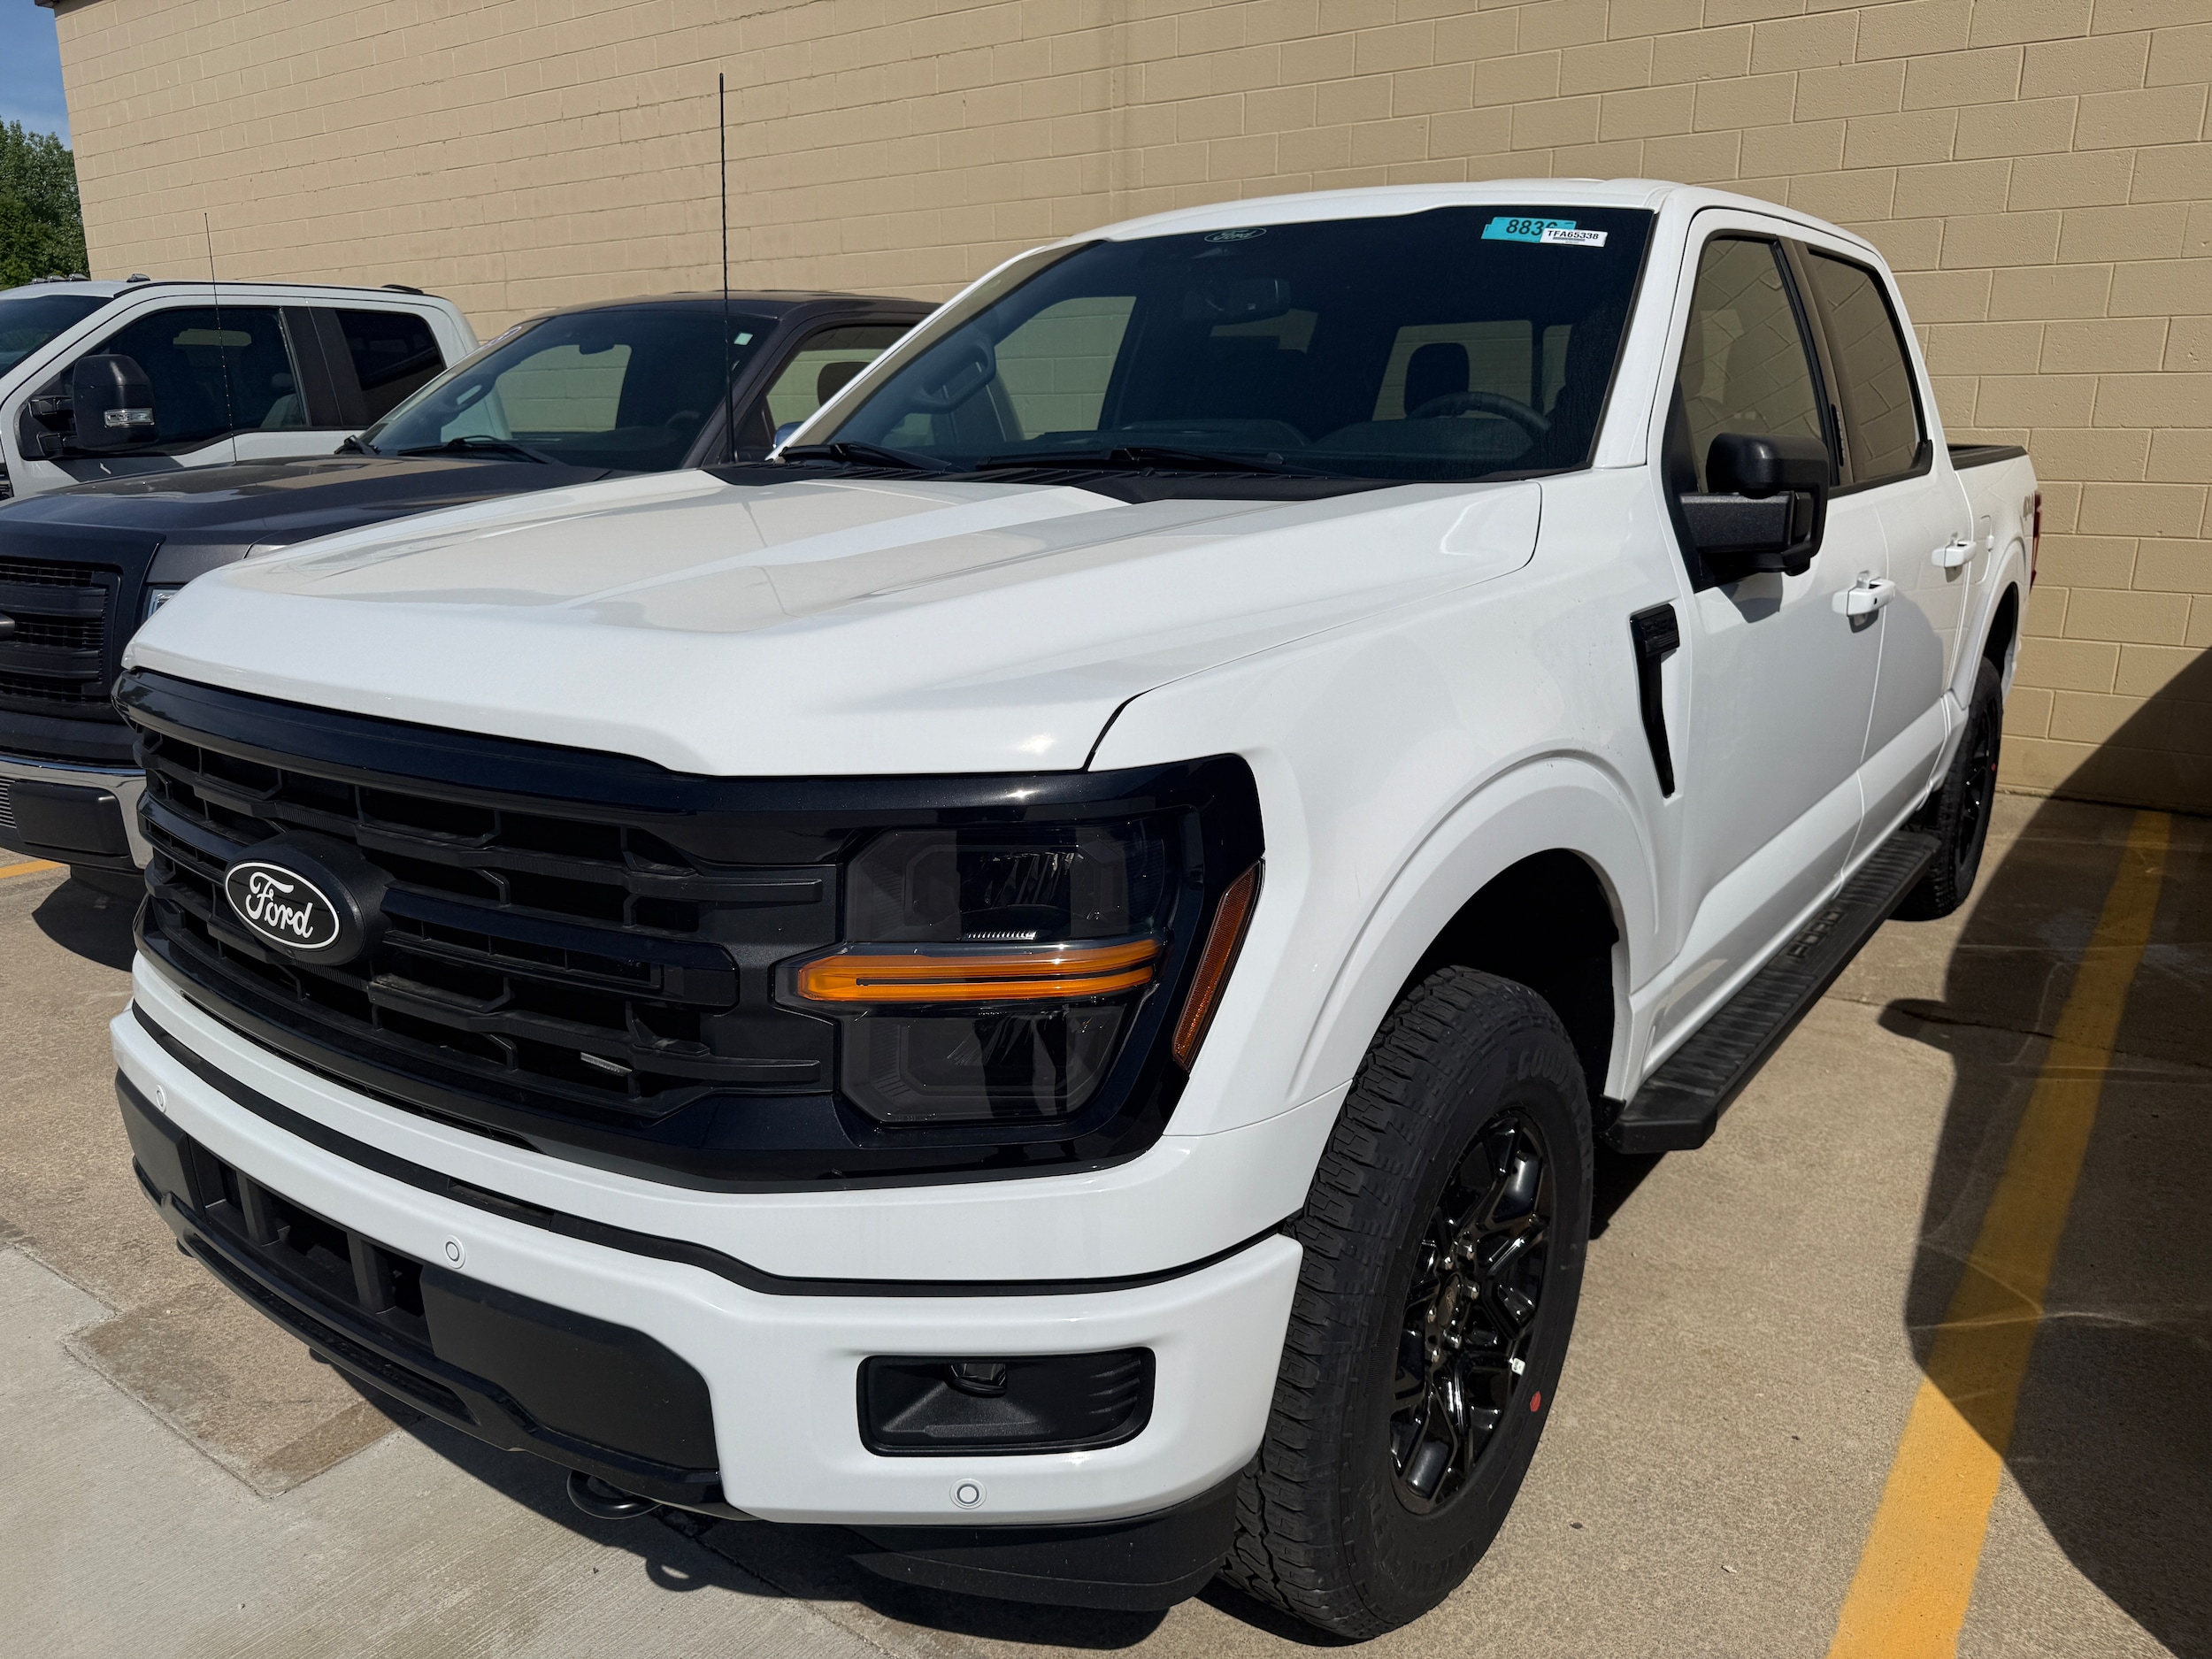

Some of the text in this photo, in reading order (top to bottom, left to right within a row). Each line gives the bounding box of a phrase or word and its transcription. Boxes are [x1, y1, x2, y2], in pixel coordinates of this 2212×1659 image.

[1211, 229, 1257, 242] Ford
[1548, 230, 1599, 240] TFA65338
[245, 872, 313, 939] Ford
